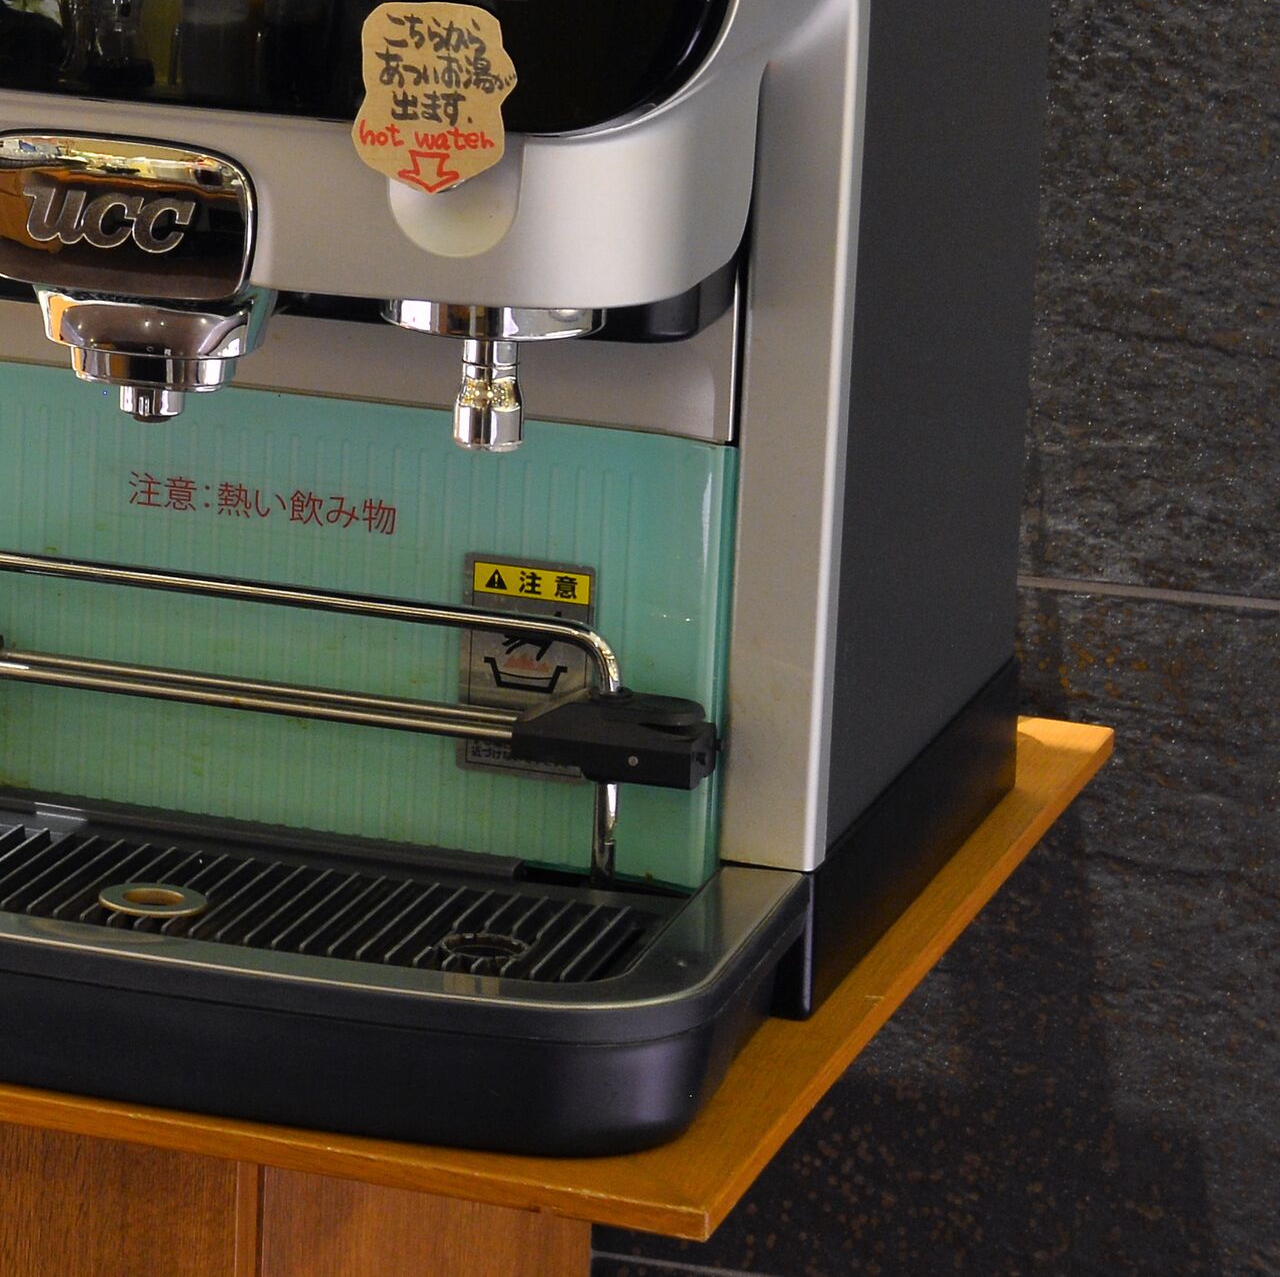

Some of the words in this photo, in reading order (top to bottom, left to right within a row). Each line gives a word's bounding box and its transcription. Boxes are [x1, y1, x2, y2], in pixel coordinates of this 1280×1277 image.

[384, 13, 486, 56] こちらから
[375, 47, 517, 94] あついお湯が
[359, 119, 404, 147] hot
[518, 569, 579, 600] 注意
